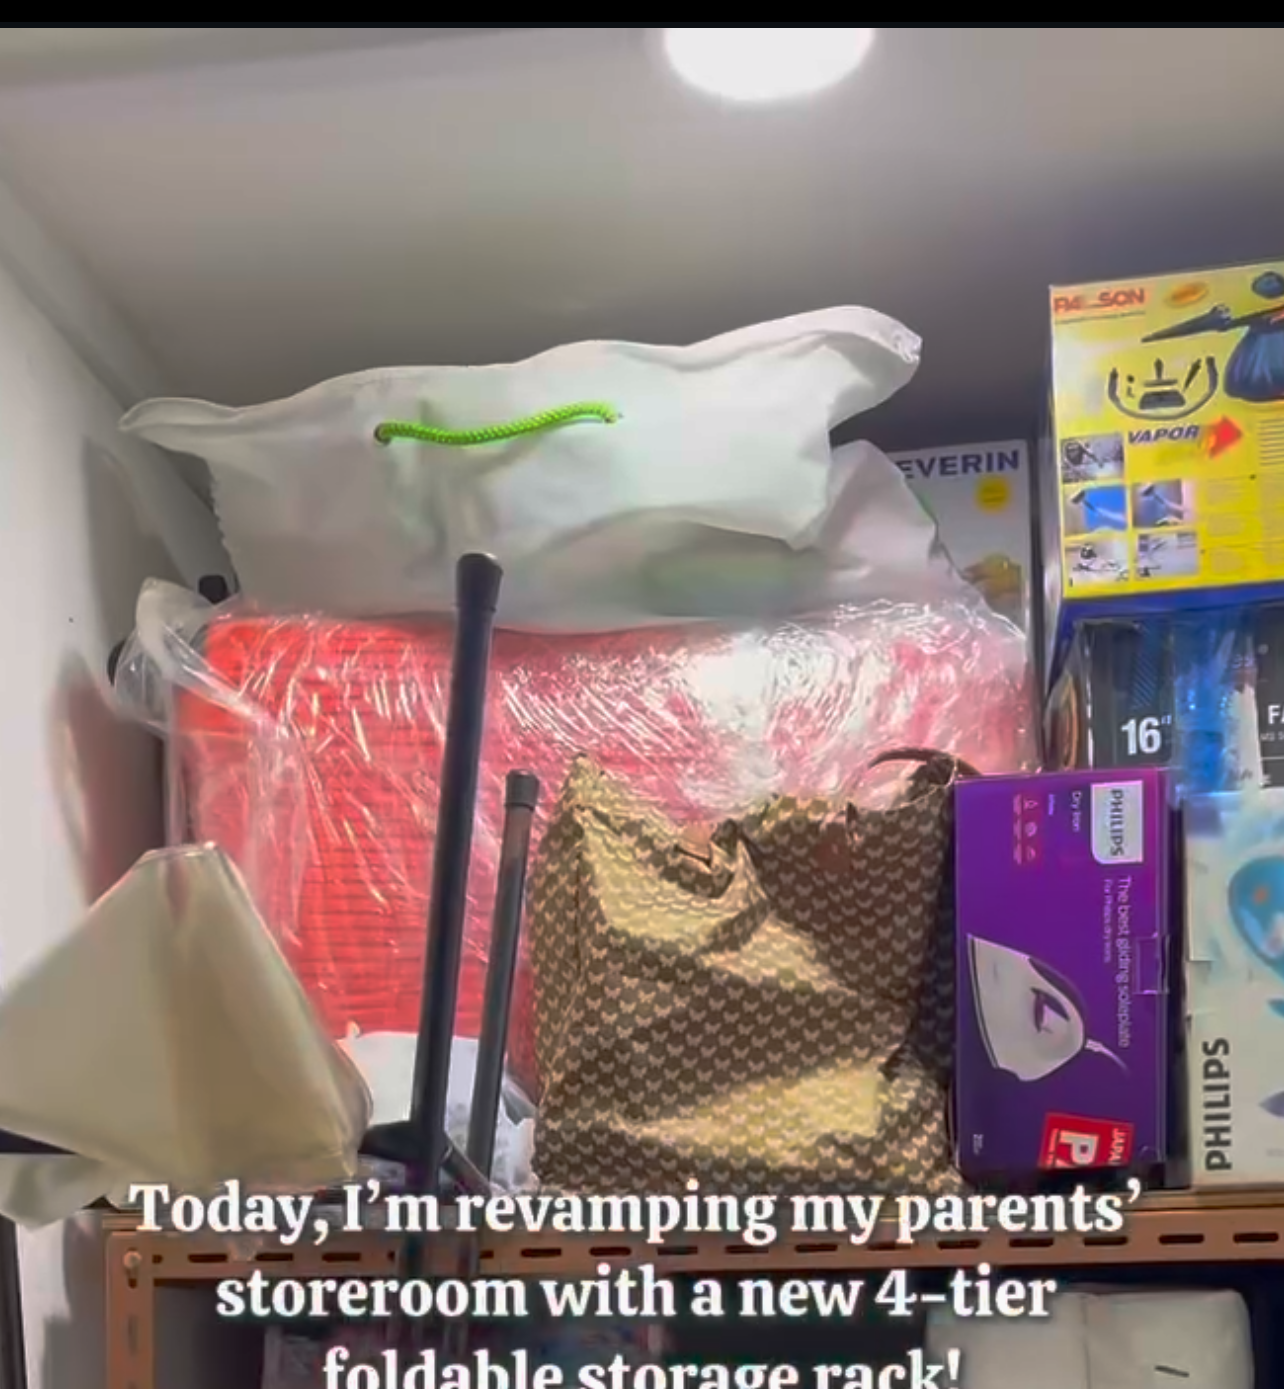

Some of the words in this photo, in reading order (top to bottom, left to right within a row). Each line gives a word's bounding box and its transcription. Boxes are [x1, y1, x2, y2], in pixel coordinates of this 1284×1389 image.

[1053, 287, 1145, 312] PASON
[1128, 425, 1201, 444] VAPOR
[895, 450, 1019, 479] EVERIN
[1069, 790, 1083, 809] Dry
[1108, 788, 1125, 857] PHILIPS
[1116, 876, 1132, 903] The
[1116, 904, 1132, 935] best
[1113, 938, 1132, 982] gliding
[1114, 984, 1132, 1047] soleplate
[1202, 1037, 1232, 1171] PHILIPS
